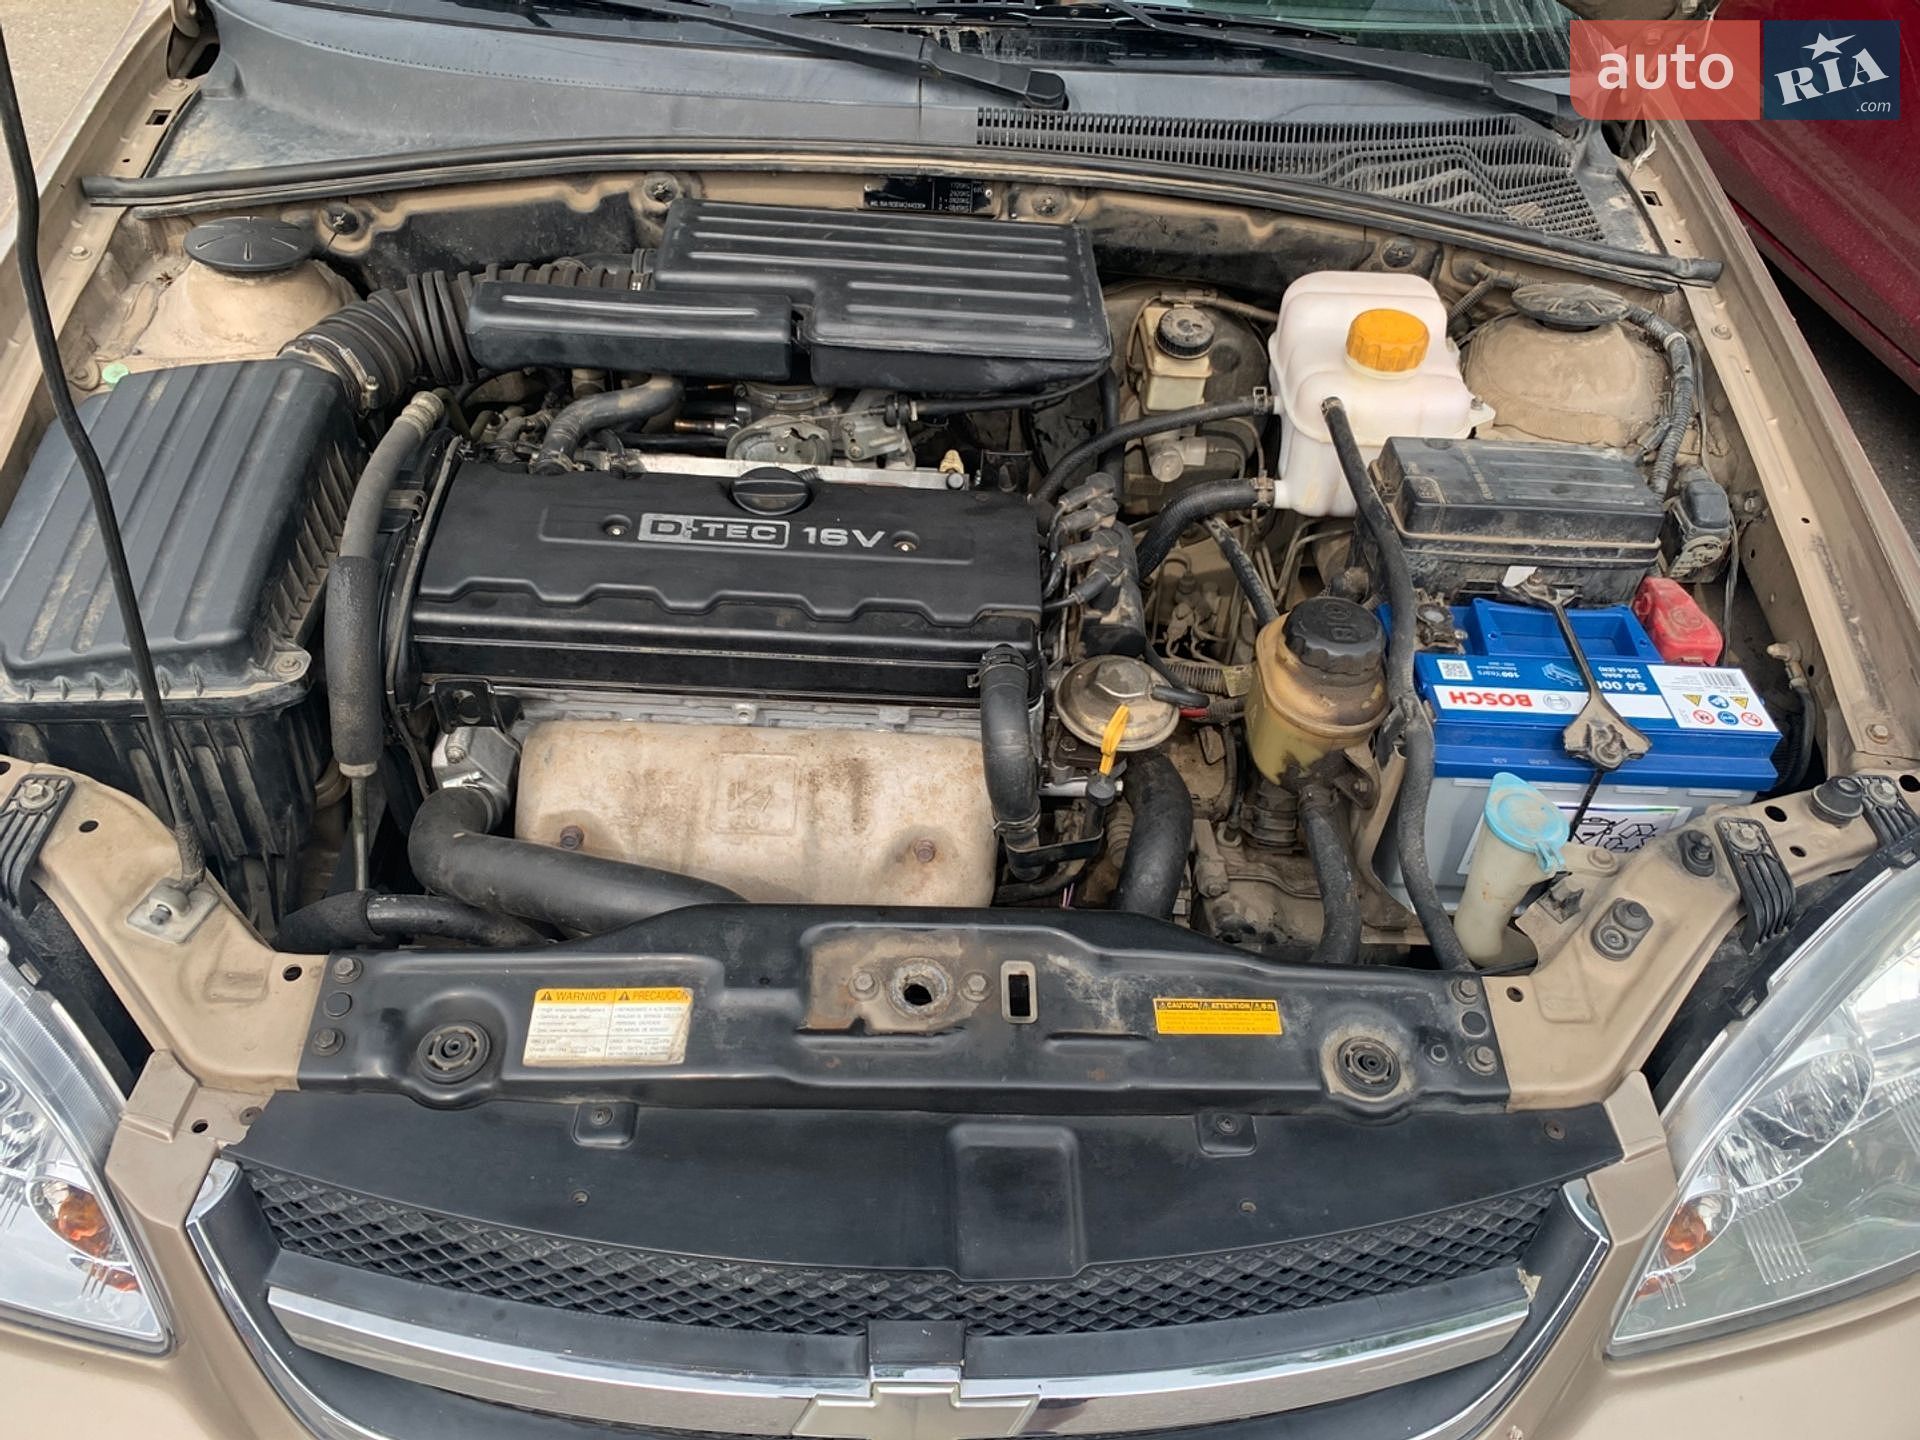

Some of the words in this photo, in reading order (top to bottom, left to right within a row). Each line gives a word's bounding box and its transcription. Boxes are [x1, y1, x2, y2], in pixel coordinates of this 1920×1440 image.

[803, 526, 886, 548] 16V
[1625, 682, 1648, 692] S4
[1449, 690, 1534, 707] BOSCH
[556, 991, 607, 1001] WARNING
[1166, 1002, 1199, 1010] CAUTION
[1211, 1002, 1250, 1010] ATTENTION
